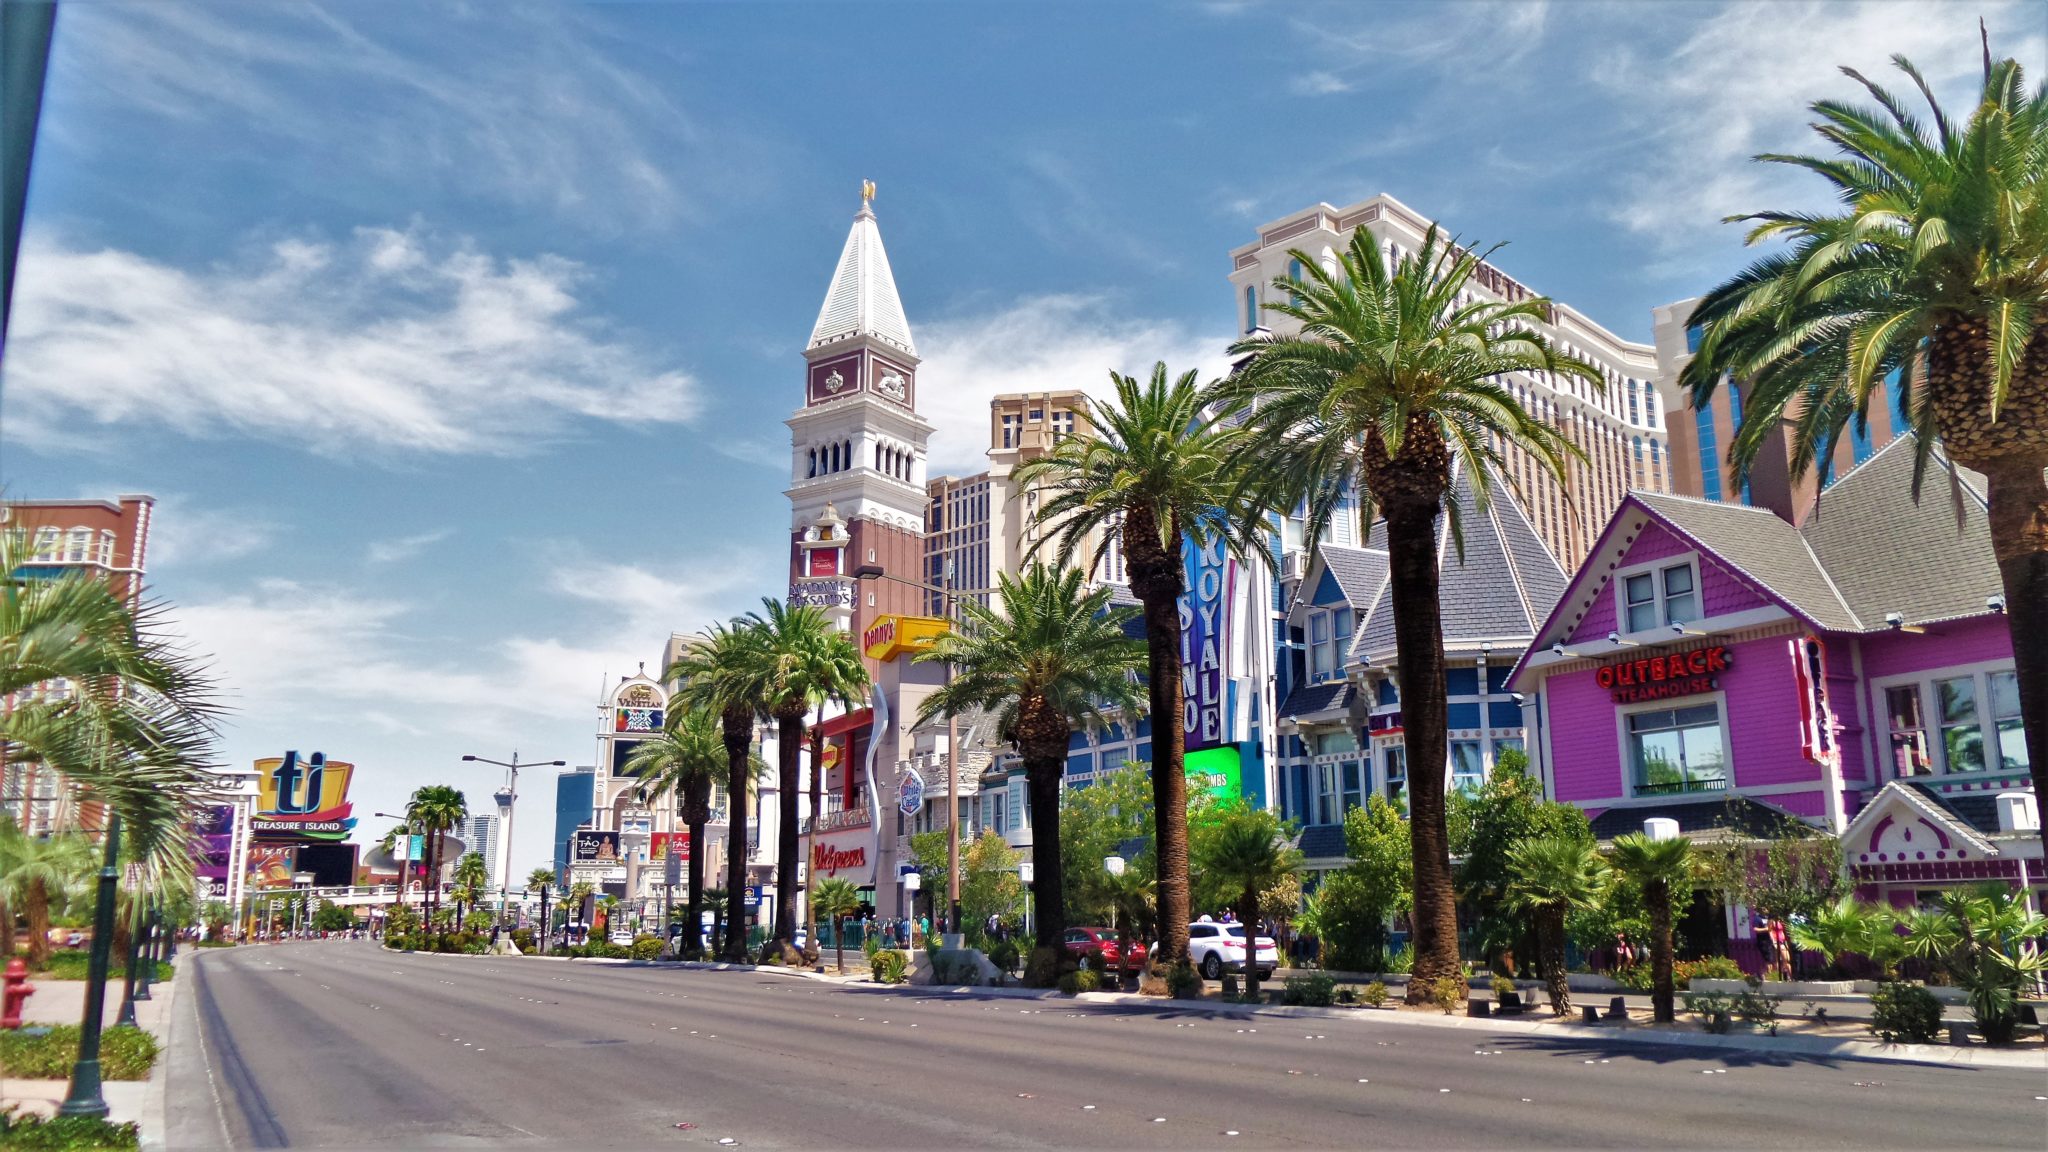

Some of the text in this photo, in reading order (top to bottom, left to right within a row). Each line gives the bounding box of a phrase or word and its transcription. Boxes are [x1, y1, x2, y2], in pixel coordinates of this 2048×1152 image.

[790, 581, 847, 594] MADAME
[864, 618, 894, 651] Denny's
[1597, 646, 1726, 689] OUTBACK
[1611, 677, 1711, 703] STEAKHOUSE
[627, 710, 653, 722] ROCK
[253, 821, 340, 831] TREASURE ISLAND
[578, 840, 600, 848] TAO
